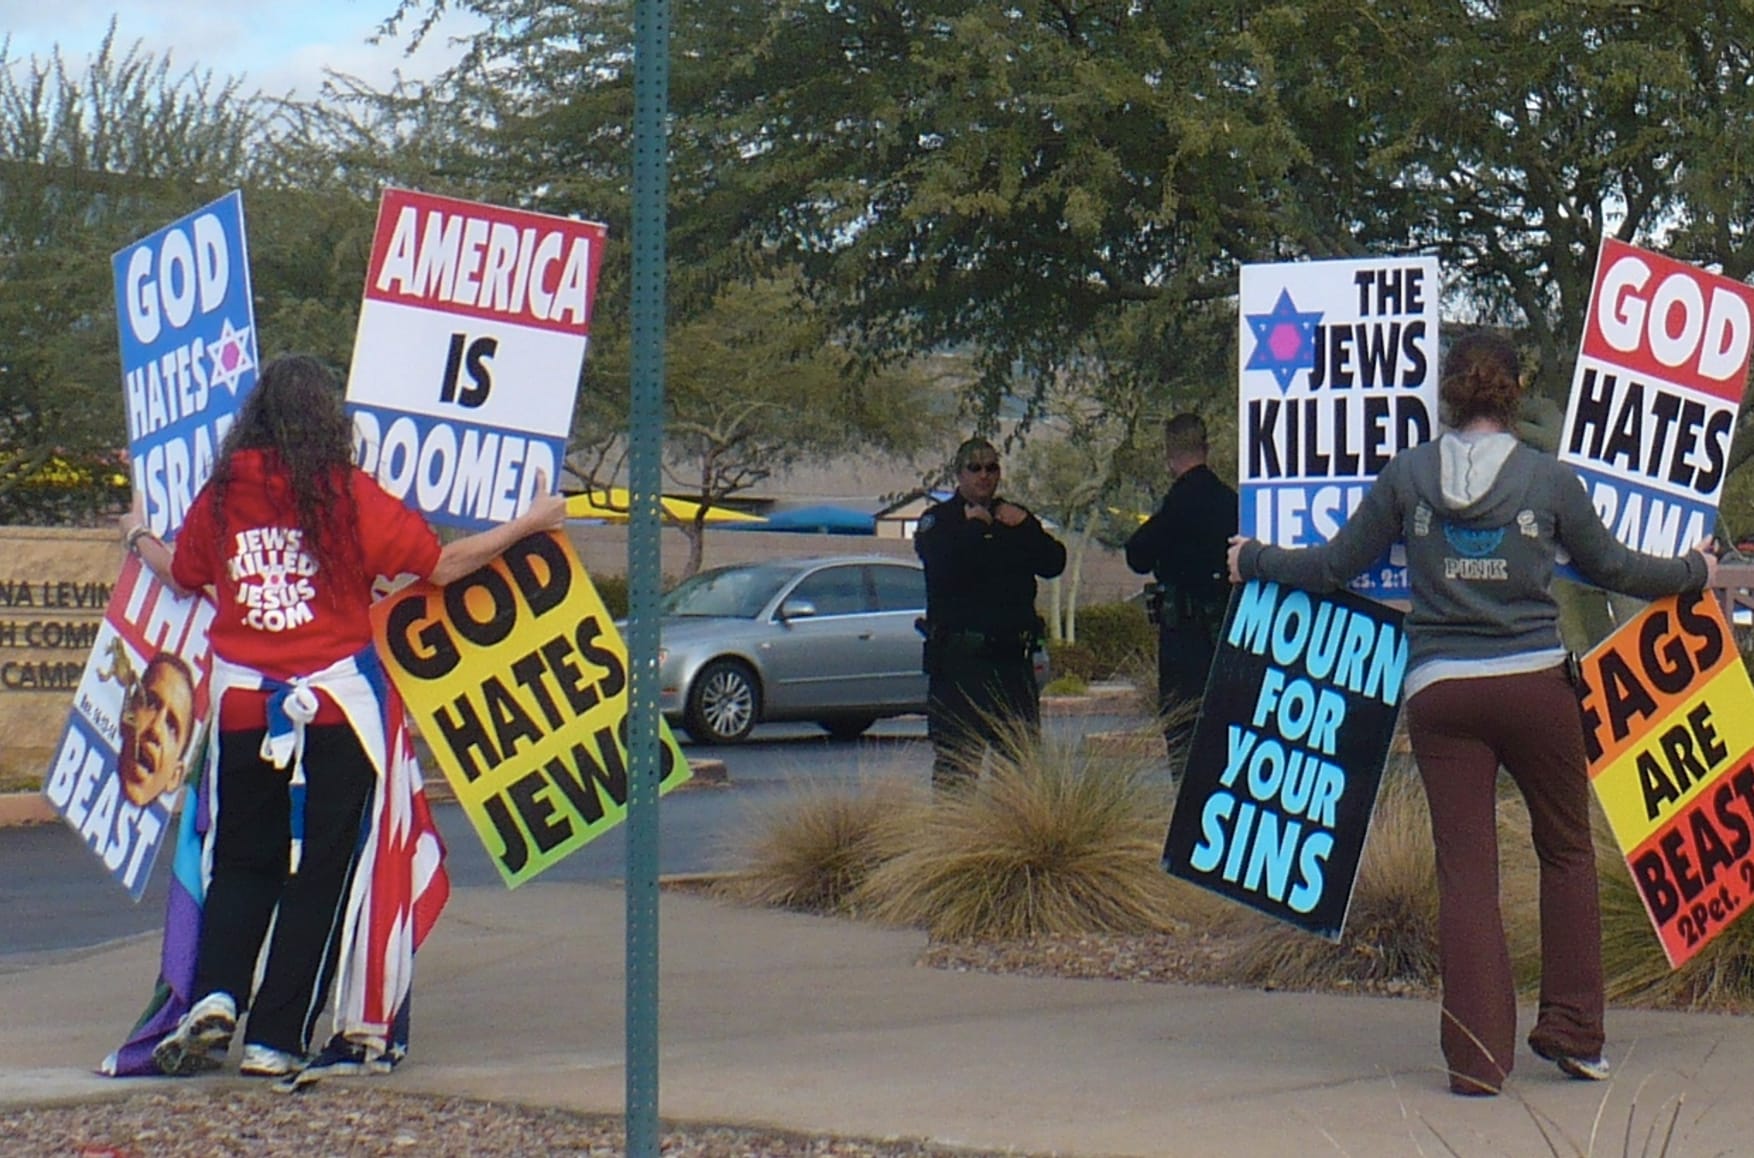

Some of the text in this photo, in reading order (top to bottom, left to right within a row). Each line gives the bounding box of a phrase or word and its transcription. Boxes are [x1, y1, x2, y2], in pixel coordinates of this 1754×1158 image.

[127, 212, 230, 344] GOD
[376, 206, 590, 325] AMERICA
[1354, 267, 1425, 317] THE
[1598, 256, 1751, 381] GOD
[127, 336, 210, 442] HATES
[439, 333, 499, 409] IS
[1308, 320, 1428, 392] JEWS
[133, 412, 236, 540] ISRA
[352, 410, 555, 523] DOOMED
[1248, 395, 1431, 479] KILLED
[1568, 367, 1734, 495] HATES
[228, 550, 319, 581] KILLED
[235, 527, 303, 555] JEWS
[235, 578, 316, 610] JESUS
[241, 601, 314, 632] .COM
[386, 531, 573, 681] GOD
[1228, 579, 1409, 707] MOURN
[1, 661, 87, 689] CAMP
[432, 615, 627, 783] HATES
[1253, 667, 1346, 755] FOR
[47, 724, 161, 890] BEAST
[1220, 725, 1346, 828] YOUR
[1635, 701, 1728, 823] ARE
[1190, 791, 1335, 913] SINS
